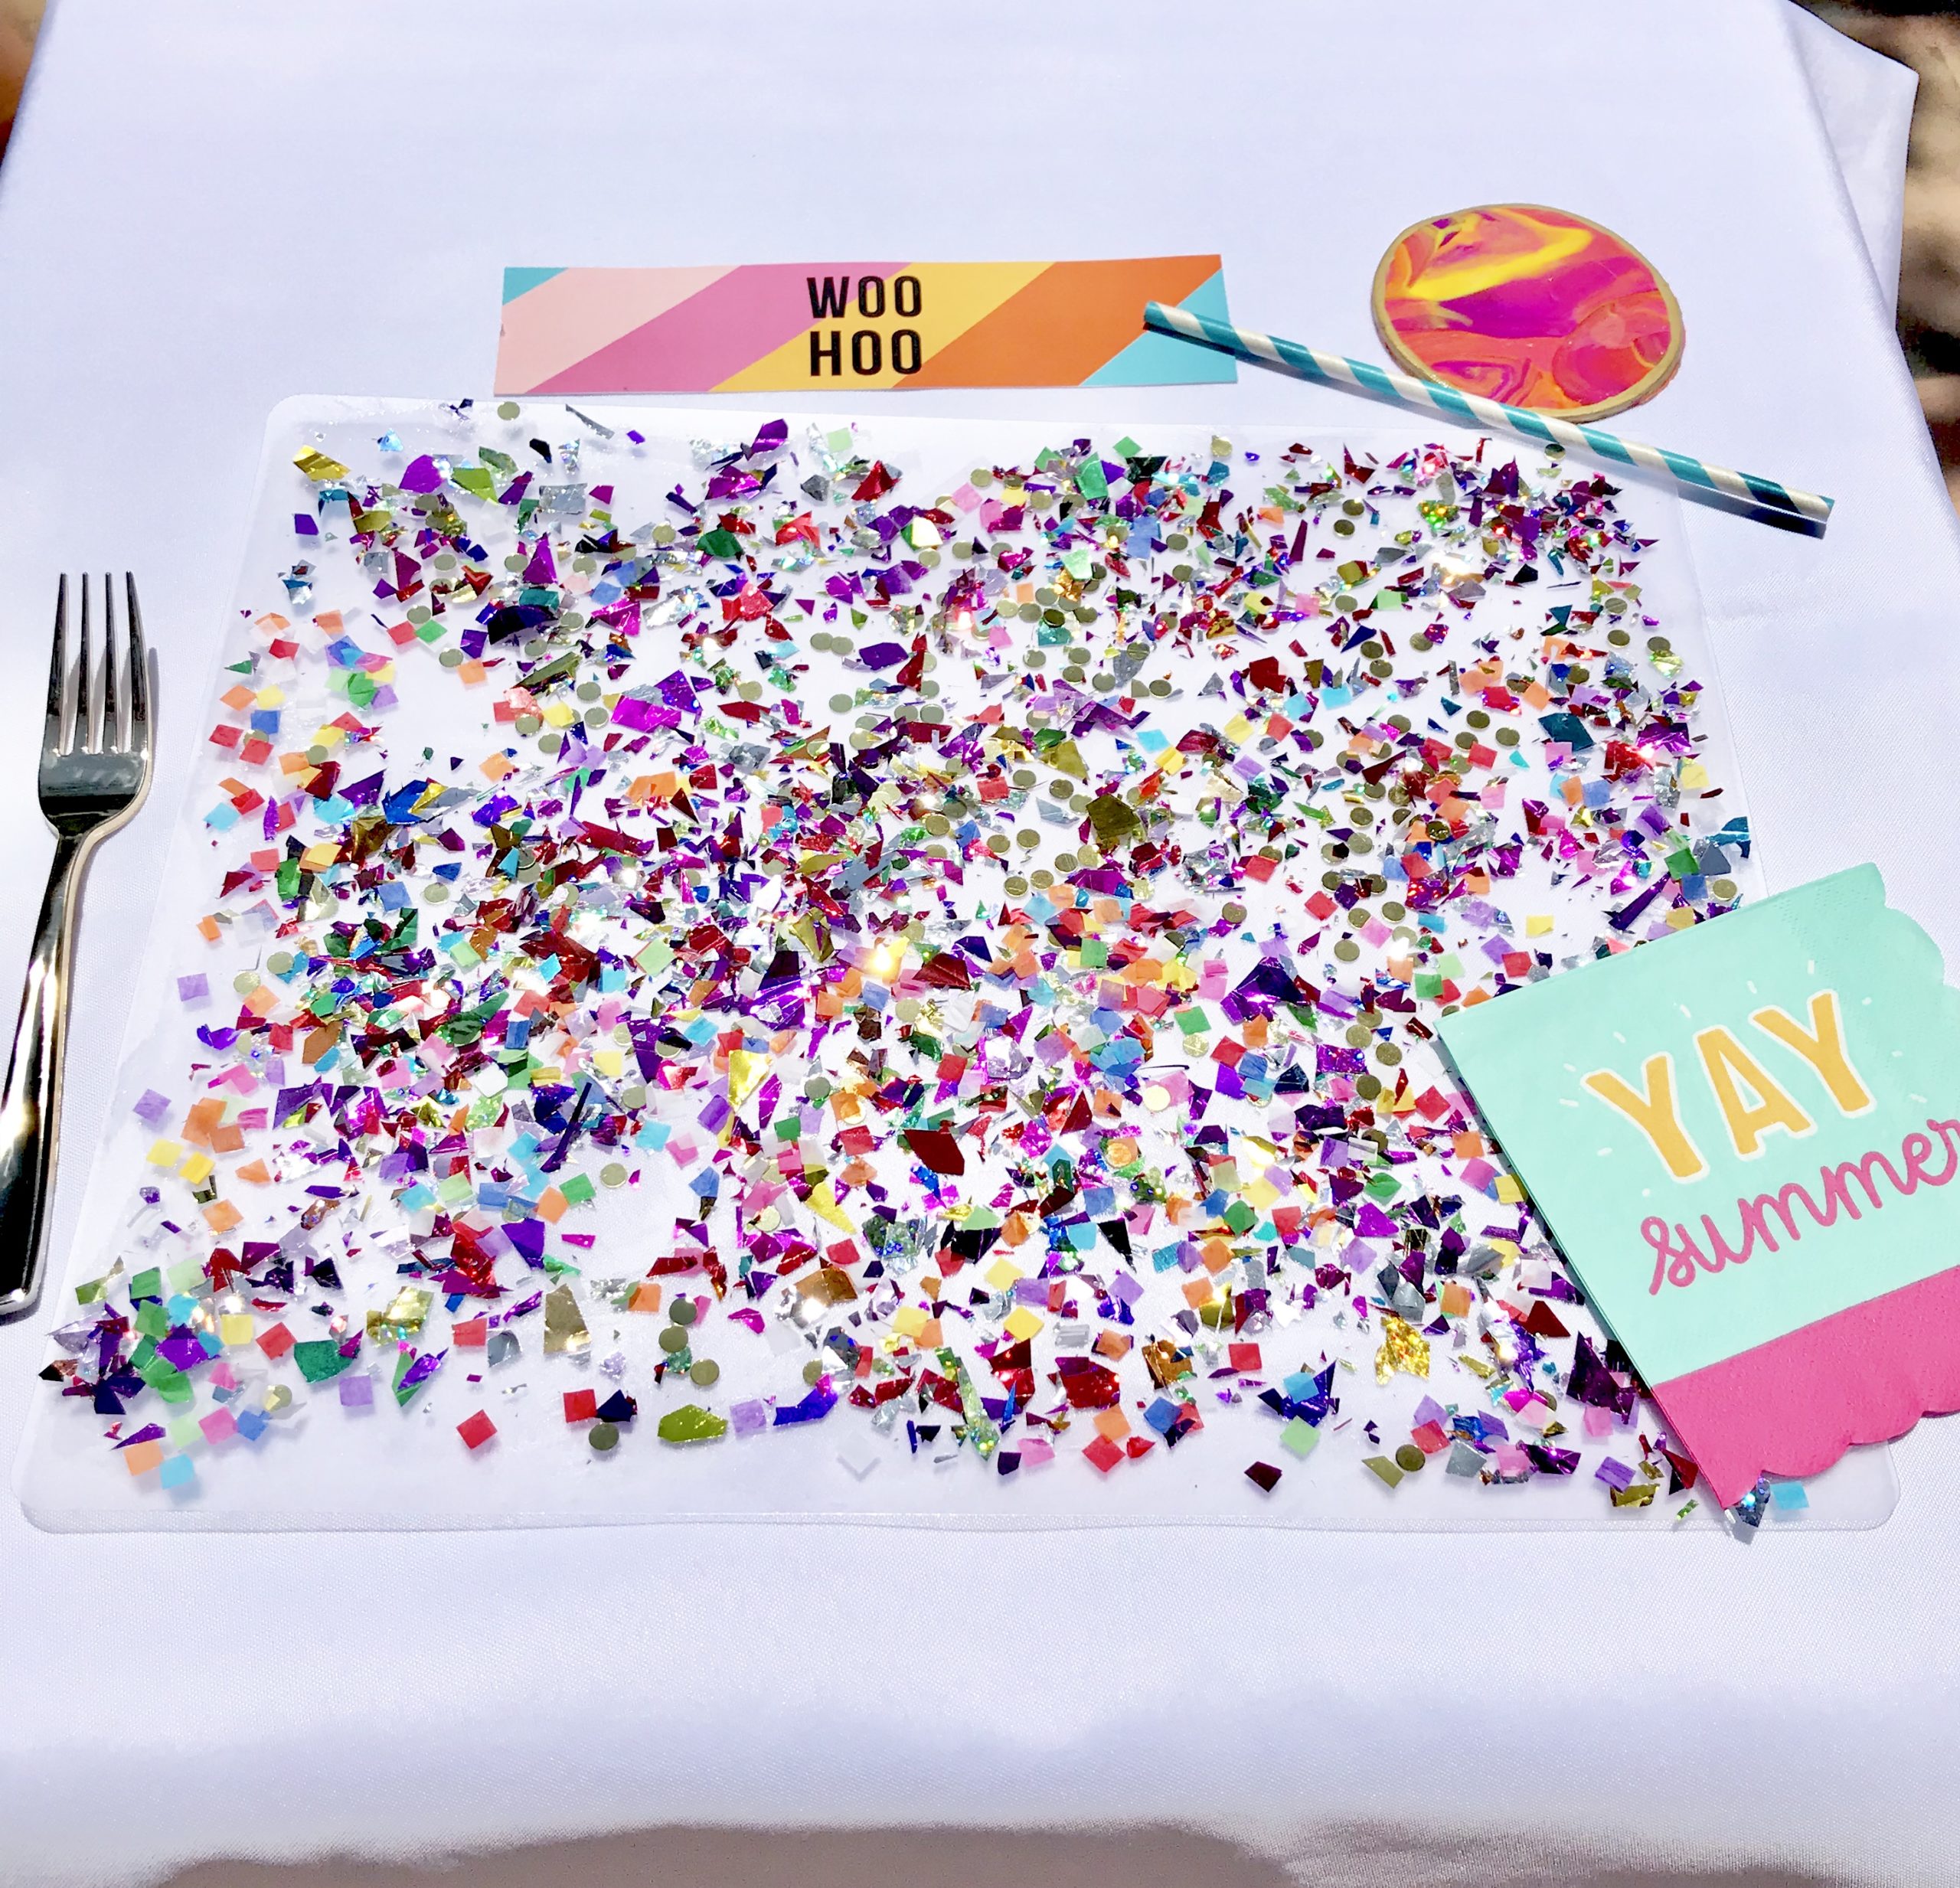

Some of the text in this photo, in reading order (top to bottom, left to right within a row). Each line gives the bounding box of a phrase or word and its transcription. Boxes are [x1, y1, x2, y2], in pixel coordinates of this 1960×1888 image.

[807, 275, 923, 318] WOO
[809, 329, 923, 377] HOO
[1581, 990, 1876, 1182] YAY
[1640, 1119, 1960, 1295] summer
